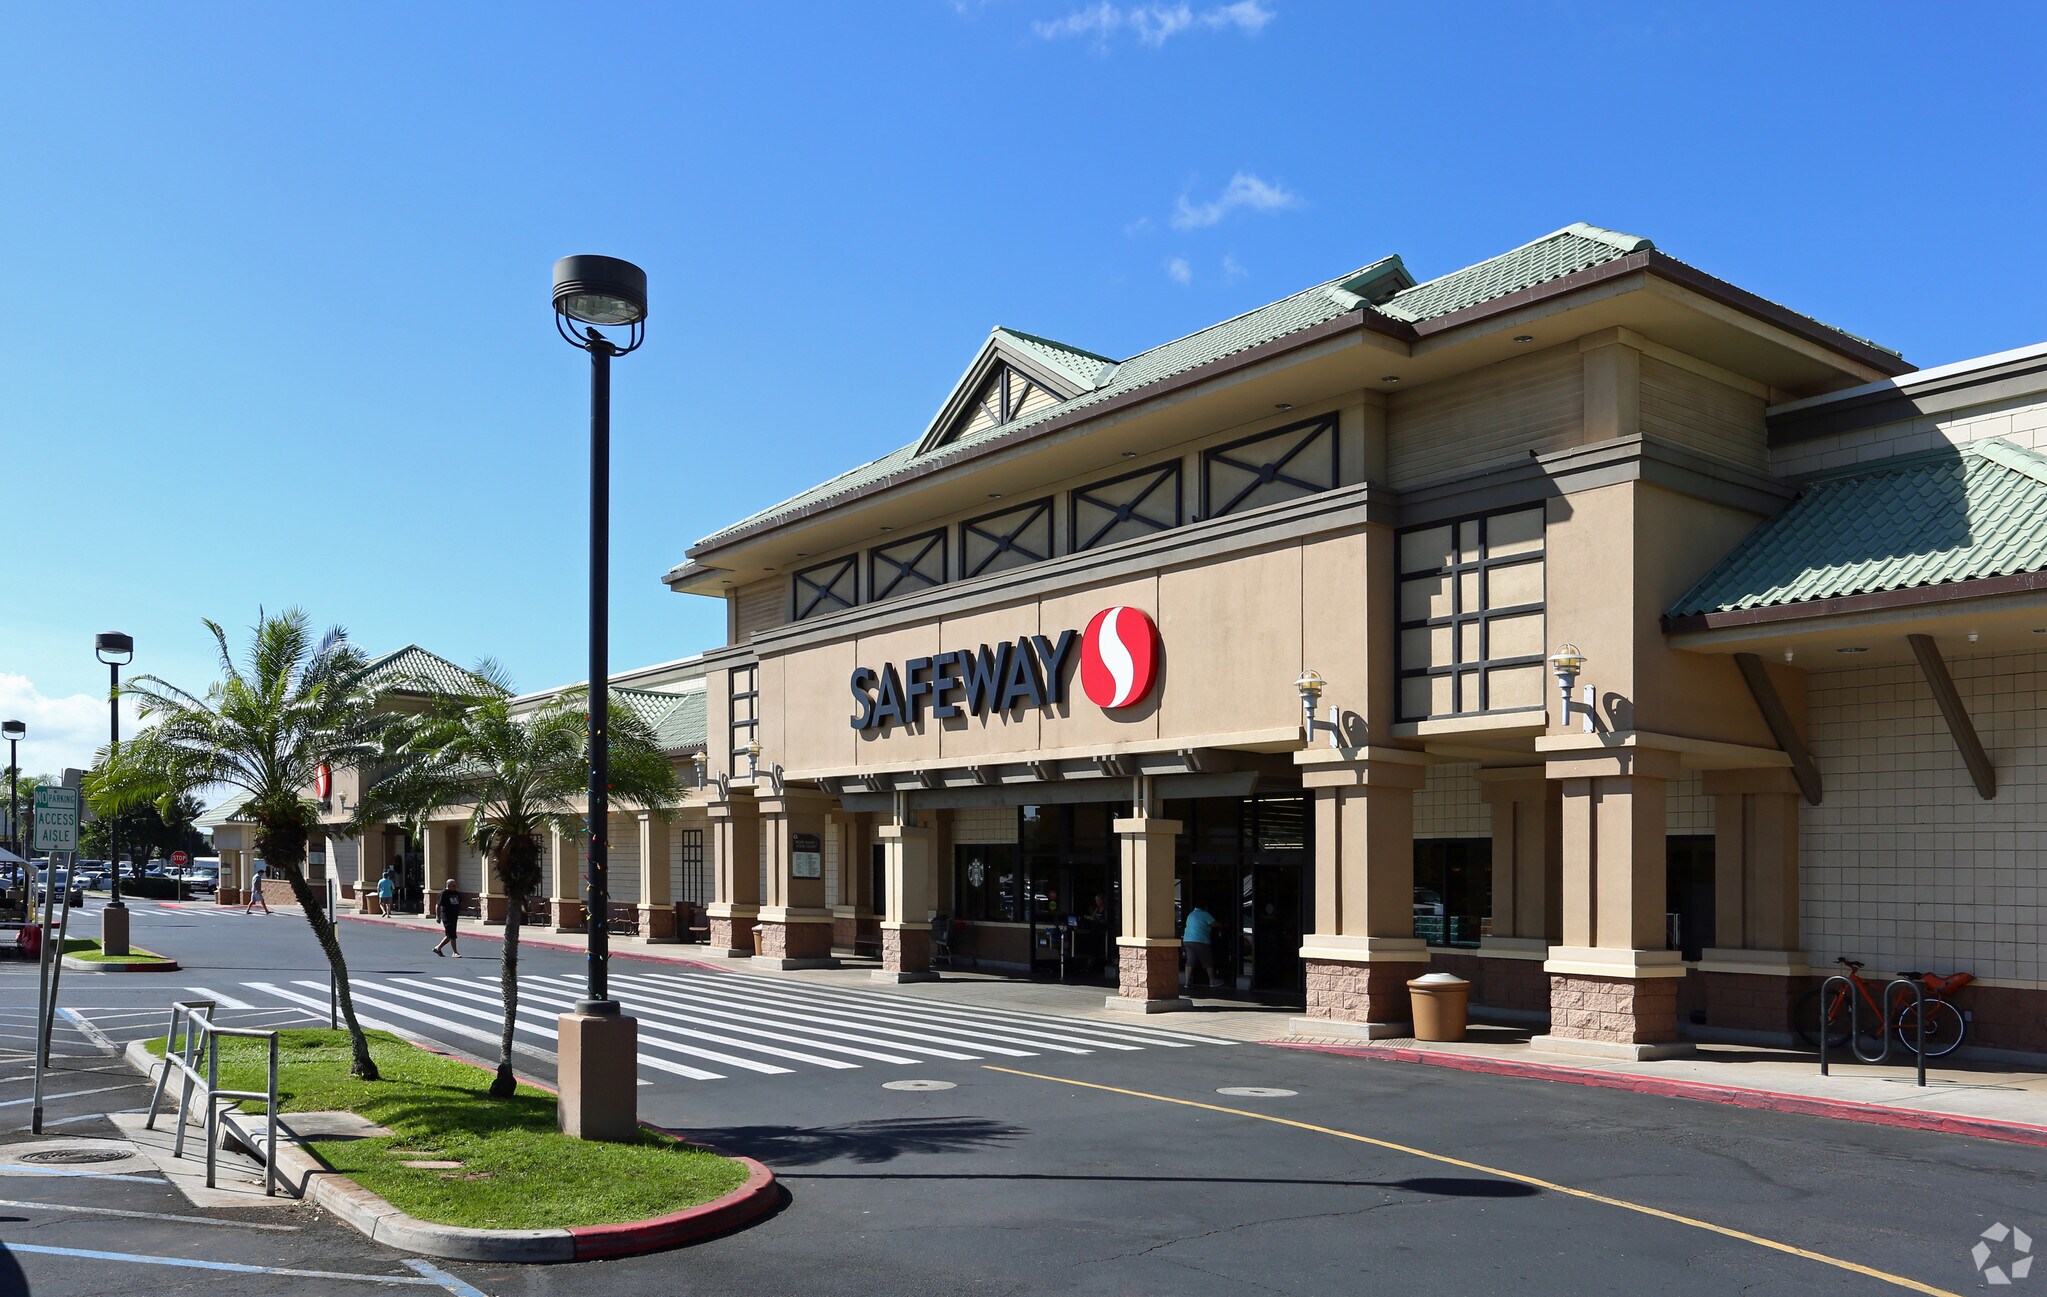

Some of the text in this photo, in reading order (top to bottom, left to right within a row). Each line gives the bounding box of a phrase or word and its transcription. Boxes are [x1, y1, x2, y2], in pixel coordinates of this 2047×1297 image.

[850, 629, 1078, 730] SAFEWAY
[36, 791, 75, 804] NO PARKING
[38, 813, 74, 826] ACCESS
[42, 830, 70, 842] AISLE
